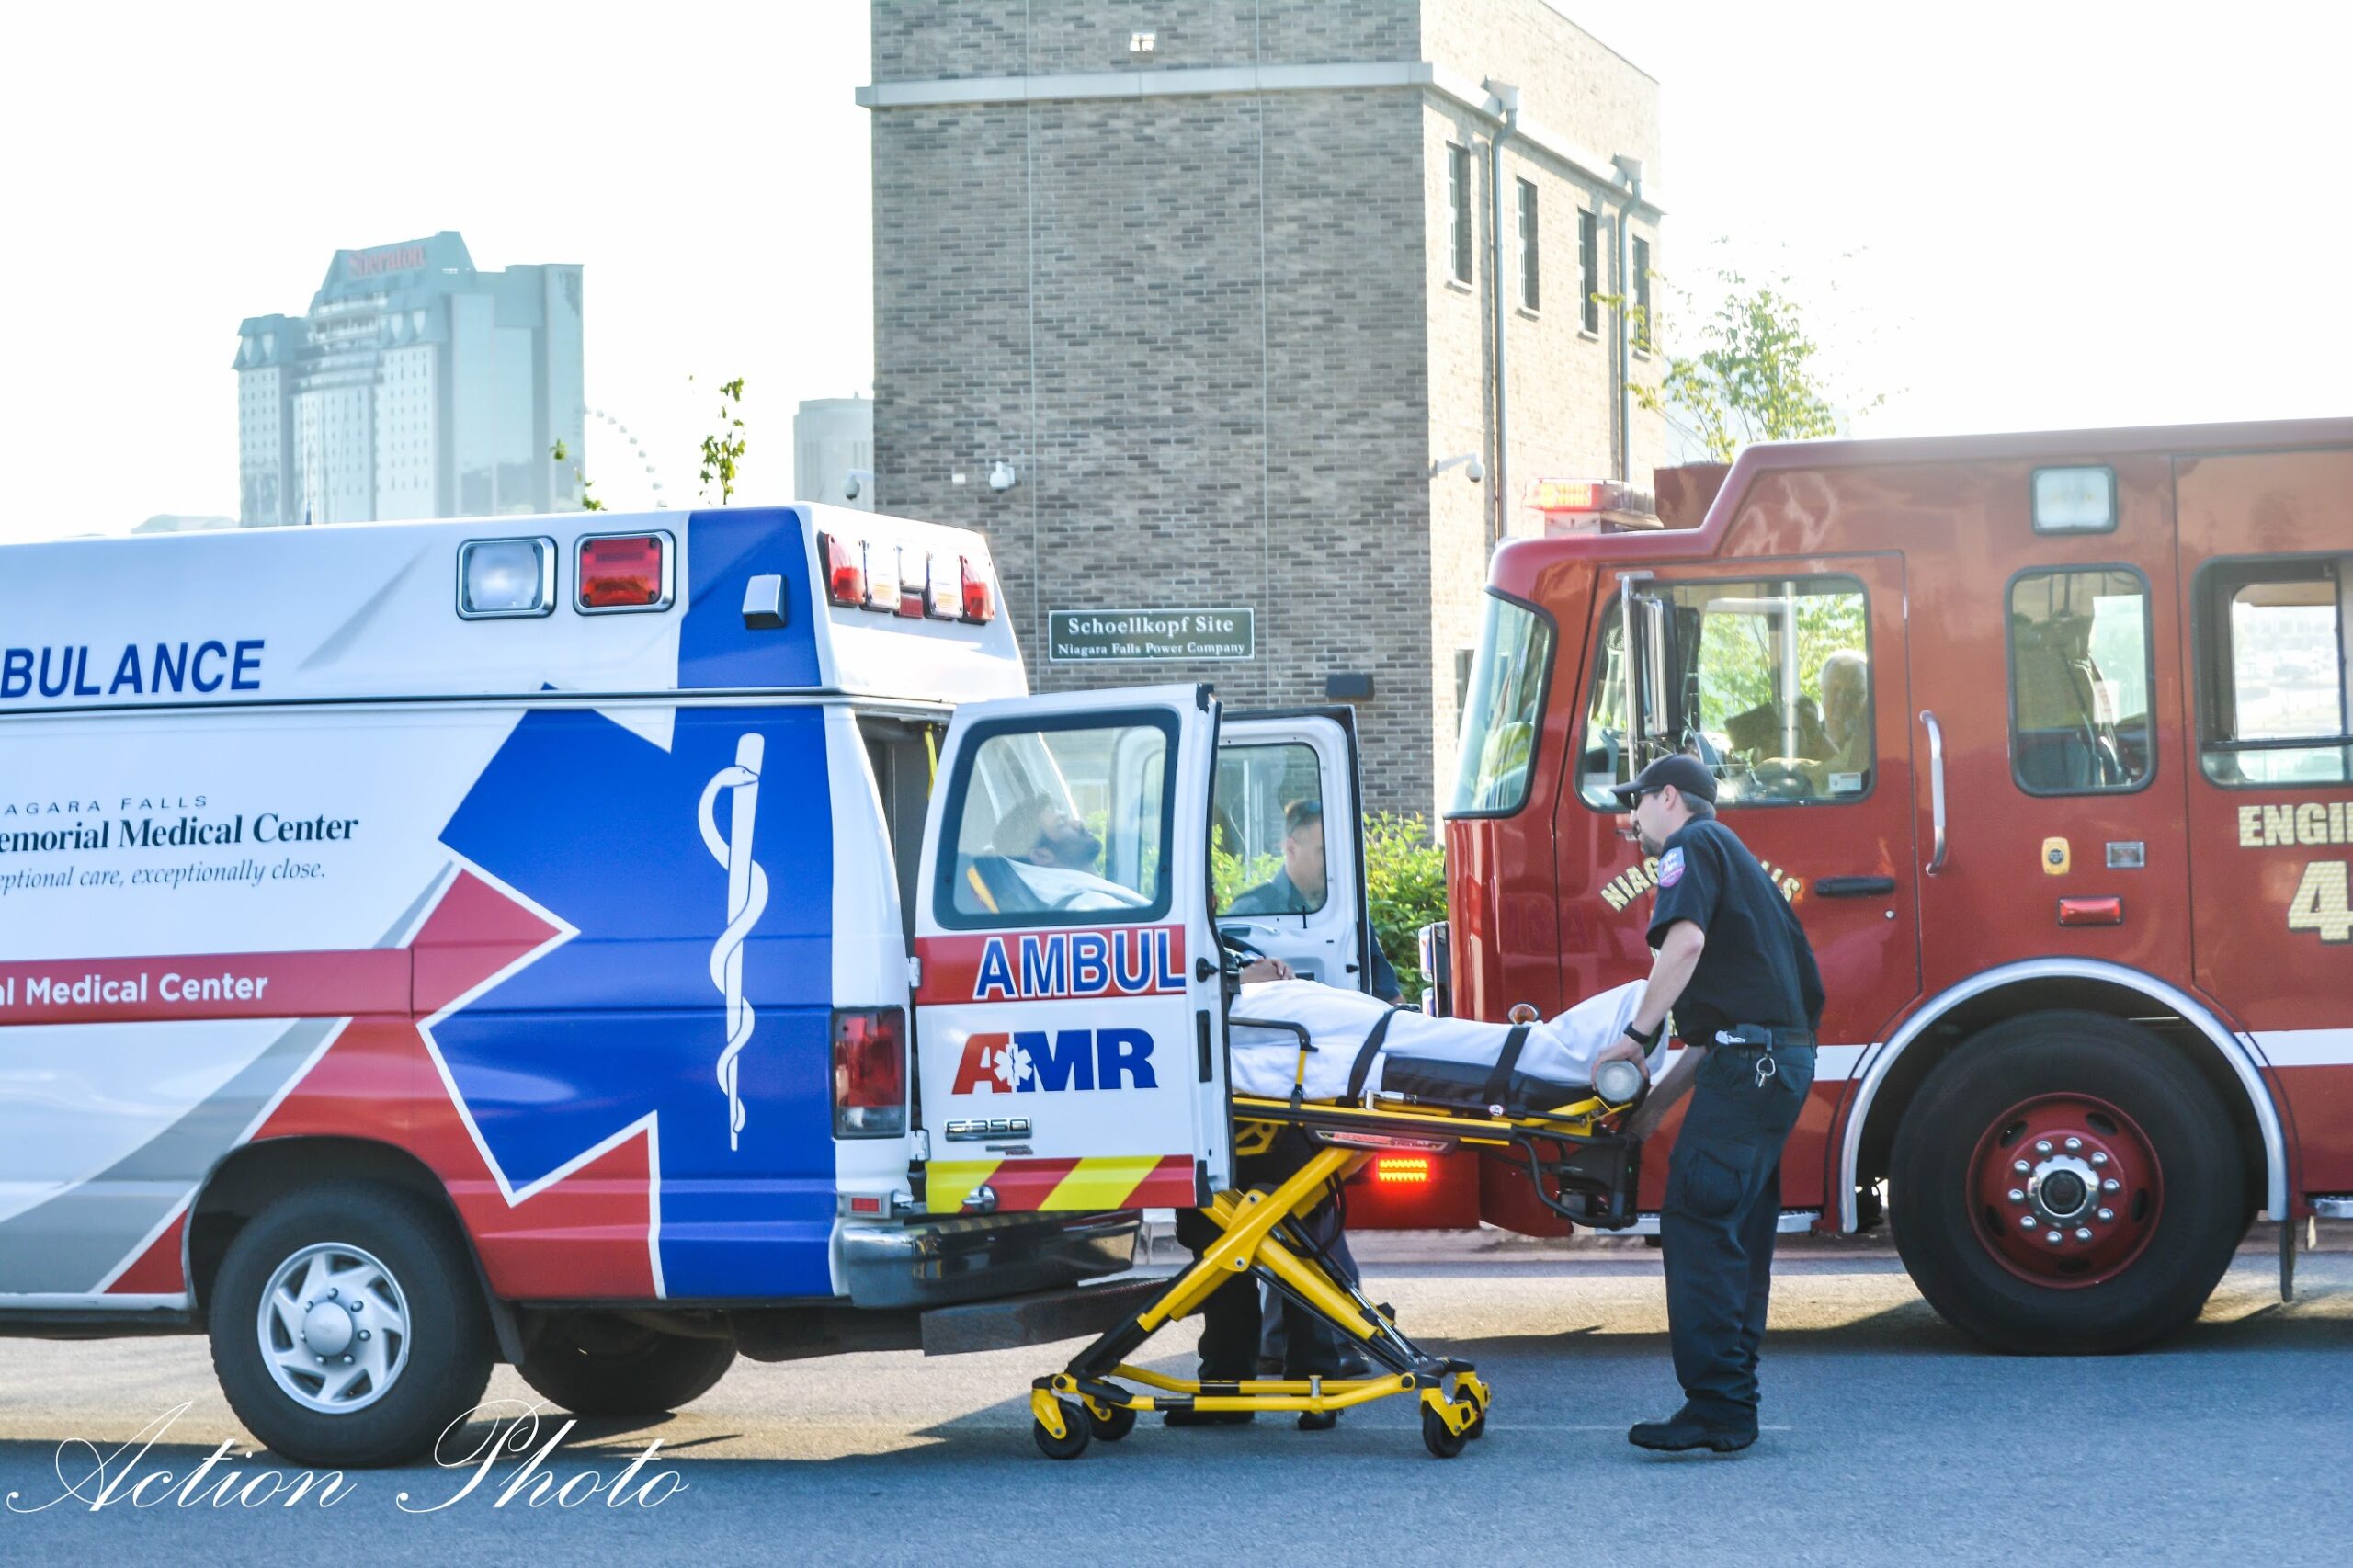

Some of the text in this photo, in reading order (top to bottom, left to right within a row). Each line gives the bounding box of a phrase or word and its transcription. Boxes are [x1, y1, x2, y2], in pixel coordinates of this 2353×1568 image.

[1068, 615, 1233, 638] Schoellkopf Site
[1057, 642, 1245, 657] Niagara Falls Power Company
[0, 640, 265, 698] BULANCE
[5, 794, 207, 816] AGARA FALLS
[118, 814, 243, 848] Medical
[253, 812, 359, 843] Center
[2238, 801, 2353, 846] ENGI
[80, 869, 125, 889] care,
[131, 858, 266, 891] exceptionally
[272, 858, 325, 879] close.
[2288, 860, 2353, 941] 4
[972, 928, 1186, 1000] AMBUL
[26, 972, 148, 1006] Medical
[159, 972, 268, 1002] Center
[951, 1028, 1159, 1095] AMR
